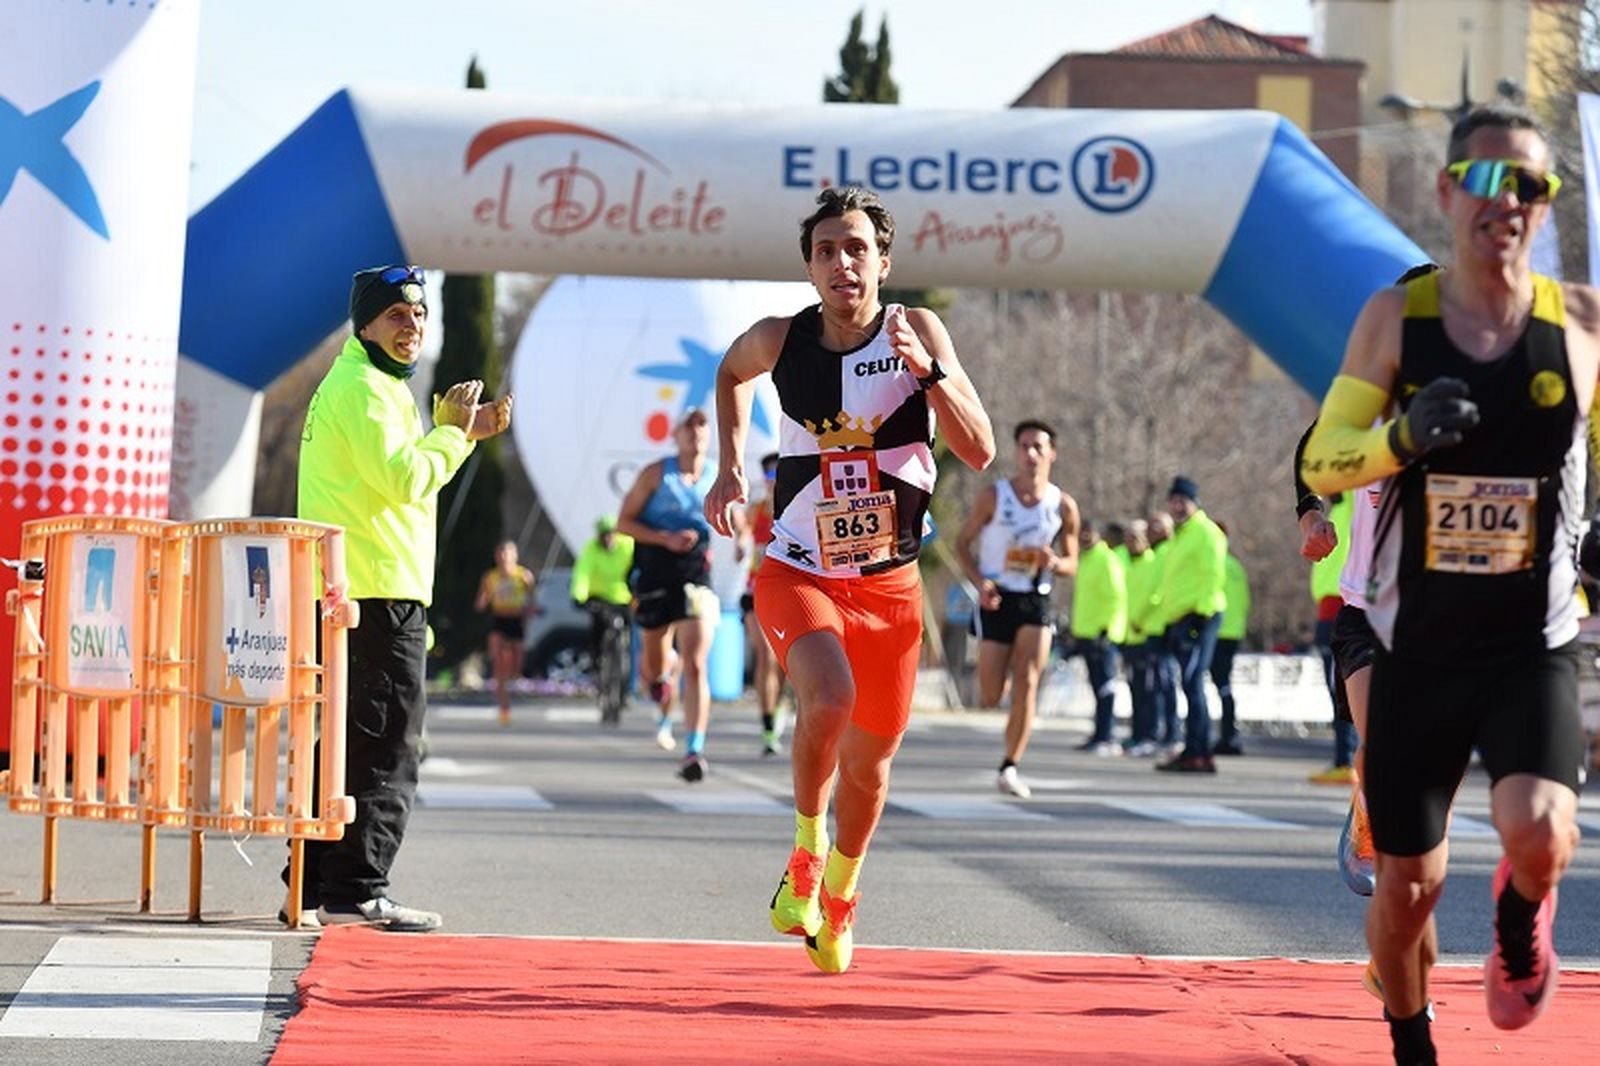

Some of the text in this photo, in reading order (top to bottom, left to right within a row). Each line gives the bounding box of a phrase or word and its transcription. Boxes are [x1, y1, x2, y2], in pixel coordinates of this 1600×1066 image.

[783, 147, 1062, 194] E.Leclerc
[473, 150, 727, 237] el Deleite
[834, 512, 880, 539] 863
[1438, 501, 1519, 532] 2104
[70, 624, 130, 658] SAVIA
